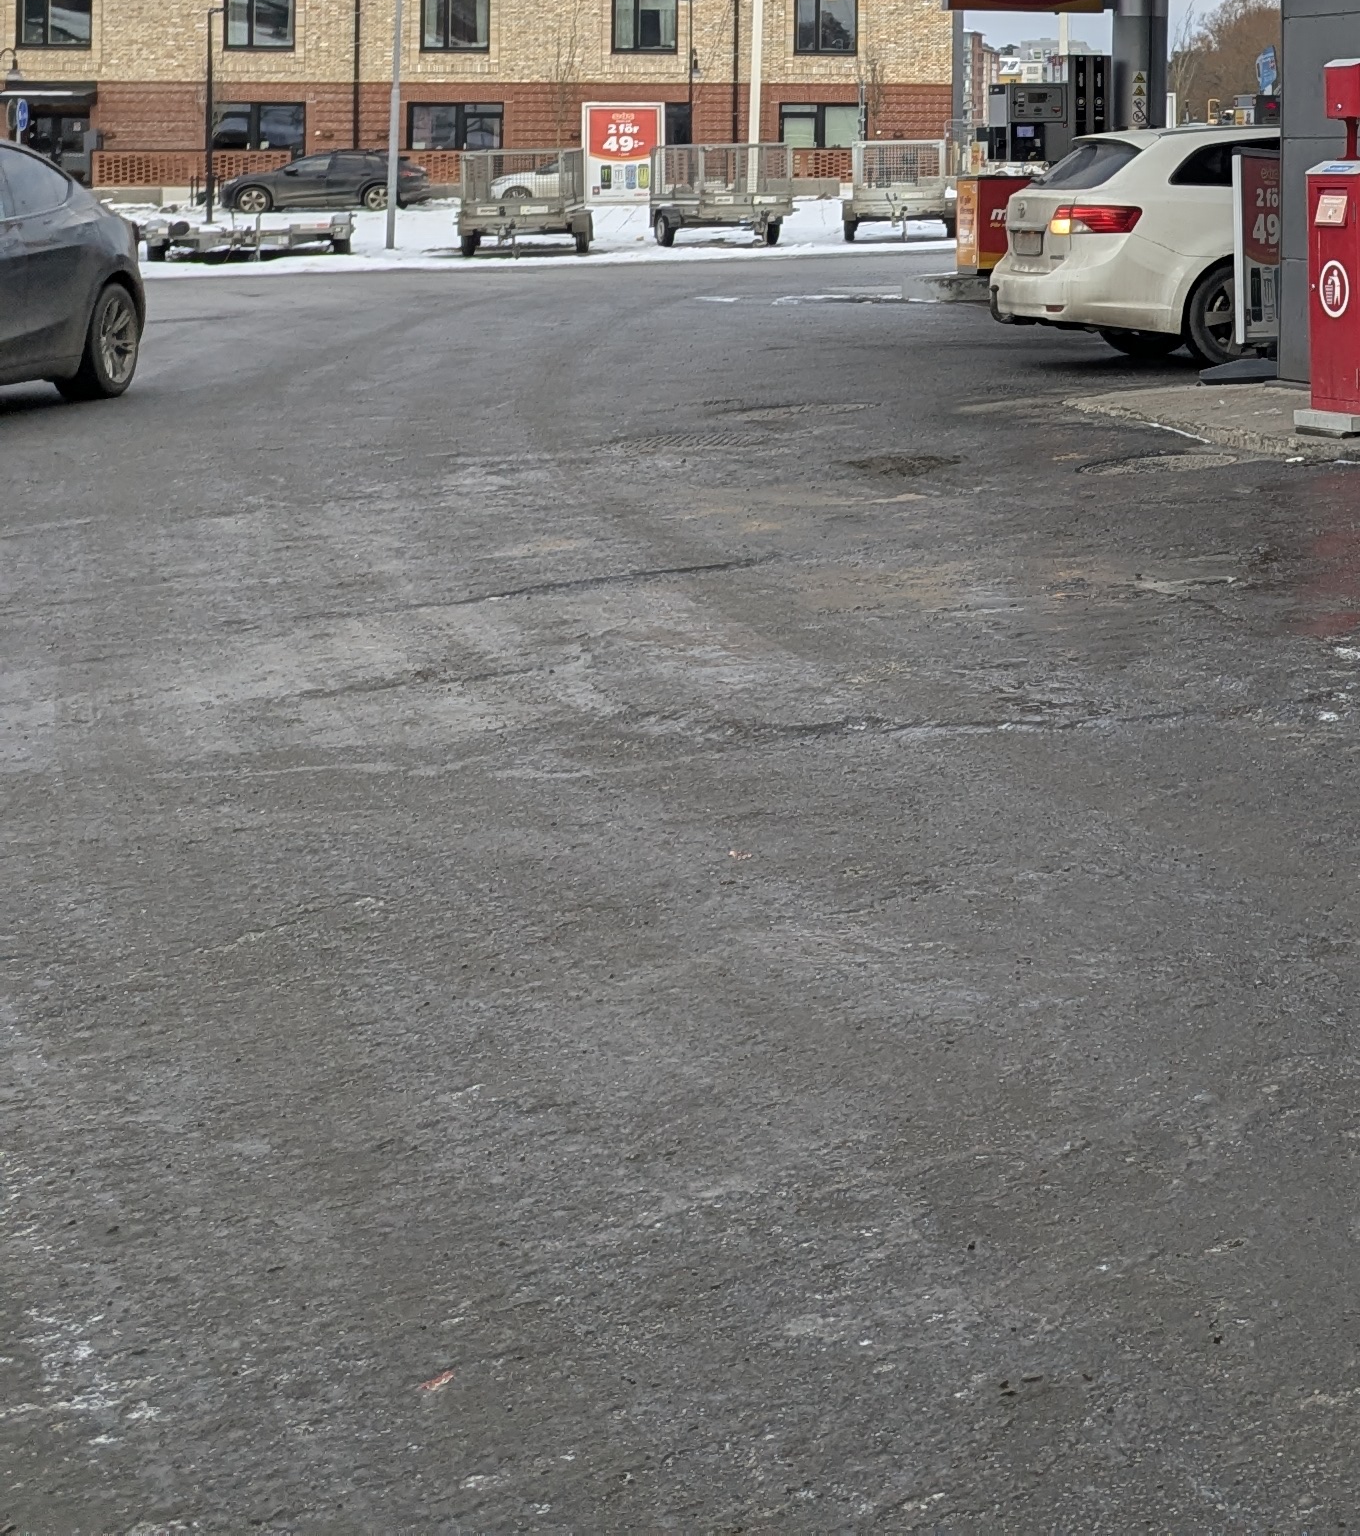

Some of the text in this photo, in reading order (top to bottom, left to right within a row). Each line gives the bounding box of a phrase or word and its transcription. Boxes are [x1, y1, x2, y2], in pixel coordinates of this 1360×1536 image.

[608, 123, 640, 134] 2 för
[1256, 187, 1279, 207] 2 fö
[1252, 213, 1280, 245] 49
